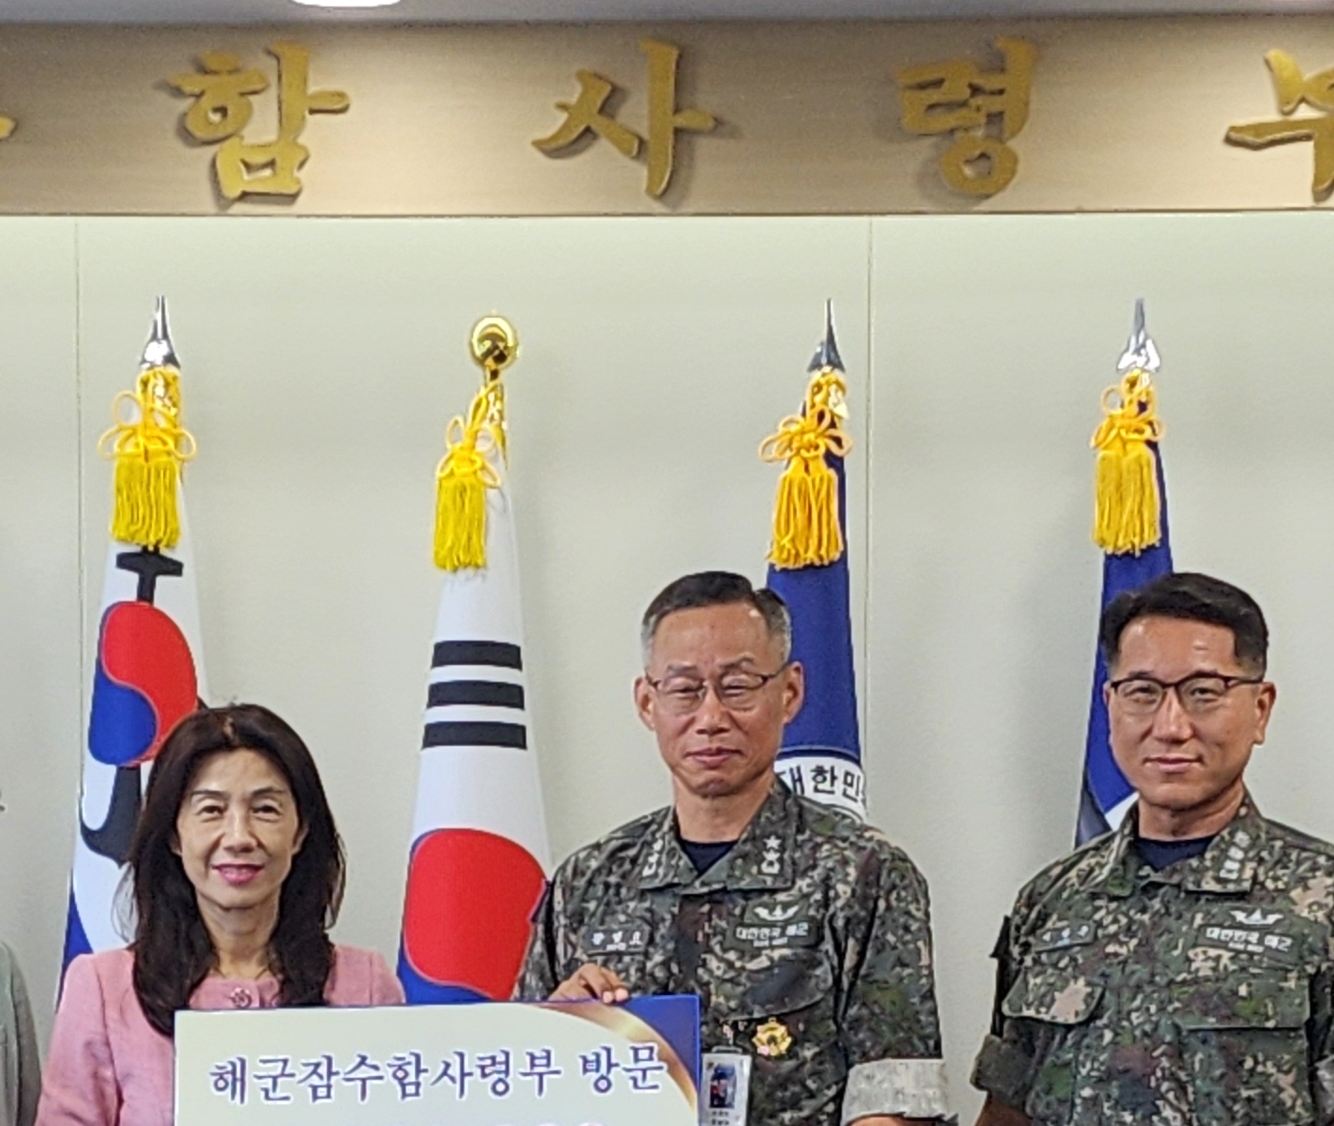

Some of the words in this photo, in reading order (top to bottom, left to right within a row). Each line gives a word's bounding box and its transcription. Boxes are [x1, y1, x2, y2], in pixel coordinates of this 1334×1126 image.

[775, 764, 865, 804] 대한민
[209, 1049, 562, 1104] 해군잠수함사령부
[579, 1044, 666, 1093] 방문
